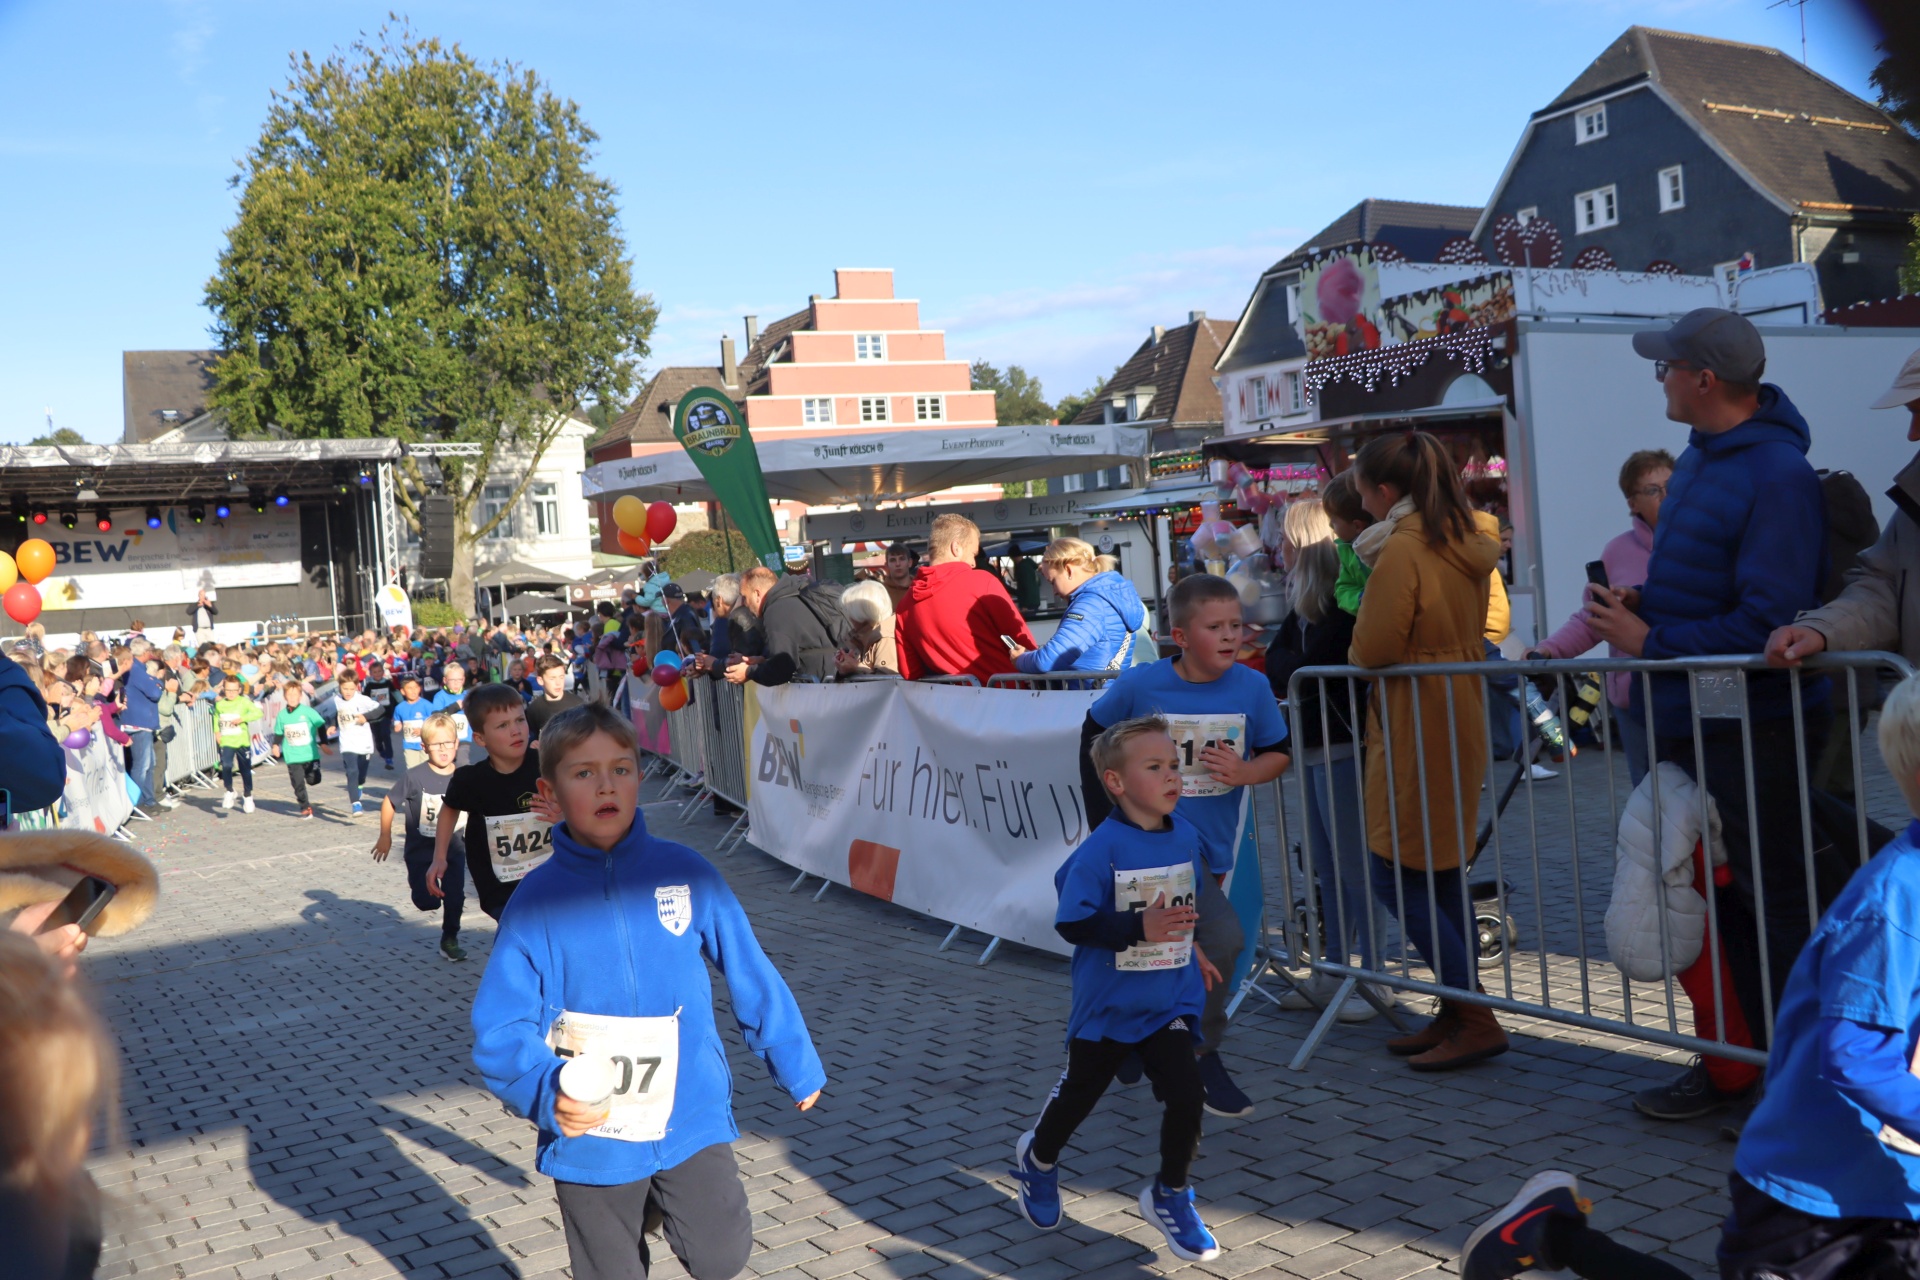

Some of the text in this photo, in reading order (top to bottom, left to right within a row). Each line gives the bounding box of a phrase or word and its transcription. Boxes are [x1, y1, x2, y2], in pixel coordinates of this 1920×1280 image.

[685, 426, 738, 446] BRAUNBRÄU
[849, 443, 876, 455] KÖLSCH
[51, 539, 130, 564] BEW
[127, 553, 163, 563] Bergische
[128, 561, 172, 571] und Wasser
[385, 608, 403, 616] BEW
[286, 729, 307, 739] 5254
[757, 732, 803, 792] BEW
[857, 741, 902, 812] Für
[975, 759, 1039, 840] Für
[1048, 783, 1091, 847] u
[496, 826, 553, 857] 5424
[1143, 873, 1169, 882] Stadtlauf
[1123, 956, 1186, 968] AOK VOSS BEW
[571, 1020, 609, 1031] Stadtlauf
[600, 1125, 622, 1135] BEW
